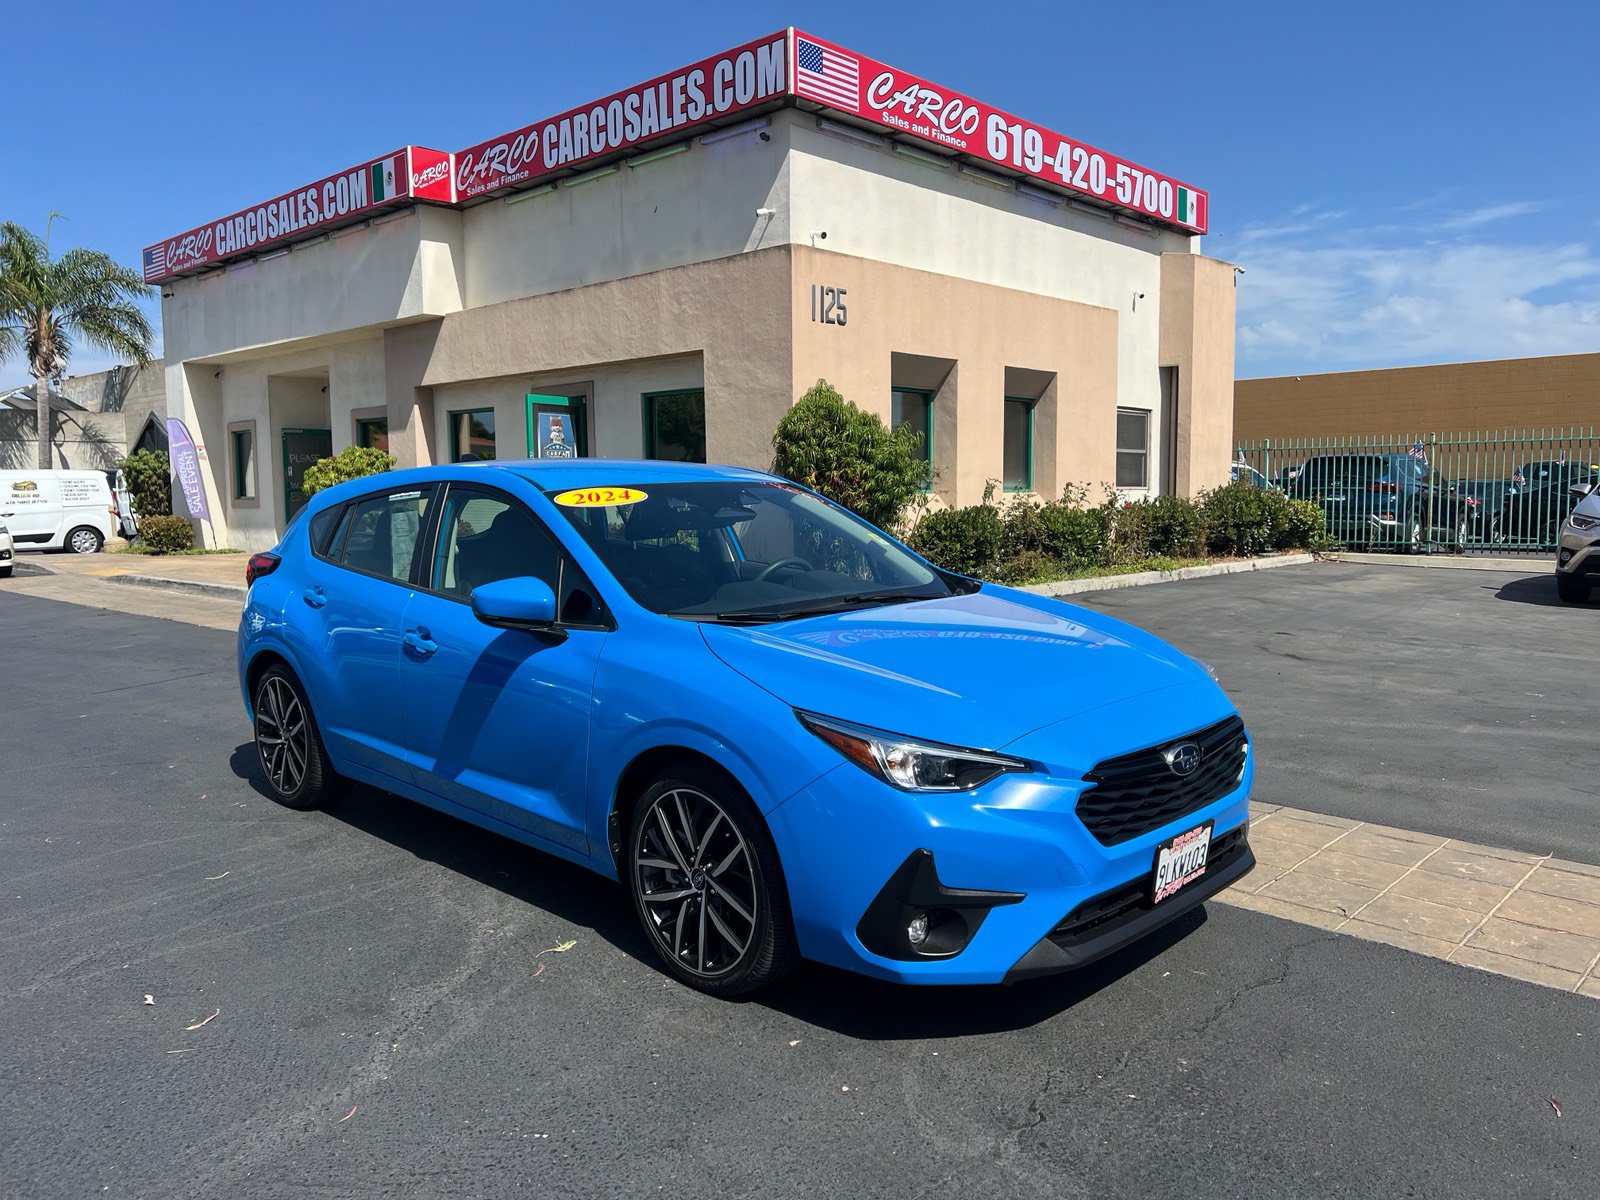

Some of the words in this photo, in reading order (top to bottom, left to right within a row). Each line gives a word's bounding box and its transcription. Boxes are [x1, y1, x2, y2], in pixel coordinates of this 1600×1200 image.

[542, 38, 786, 169] CARCOSALES.COM
[866, 71, 980, 136] CARCO
[882, 111, 910, 130] Sales
[912, 122, 929, 137] and
[931, 128, 967, 149] Finance
[413, 160, 449, 188] CARCO
[456, 130, 539, 191] CARCO
[986, 112, 1174, 218] 619-420-5700
[466, 183, 485, 197] Sales
[486, 177, 500, 190] and
[501, 169, 529, 186] Finance
[215, 168, 368, 257] CARCOSALES.COM
[166, 228, 212, 268] CARCO
[812, 284, 848, 326] 1125
[184, 450, 198, 484] EVENT
[190, 486, 204, 513] SALE
[572, 490, 631, 505] 2024
[1158, 843, 1207, 890] 9LKW103
